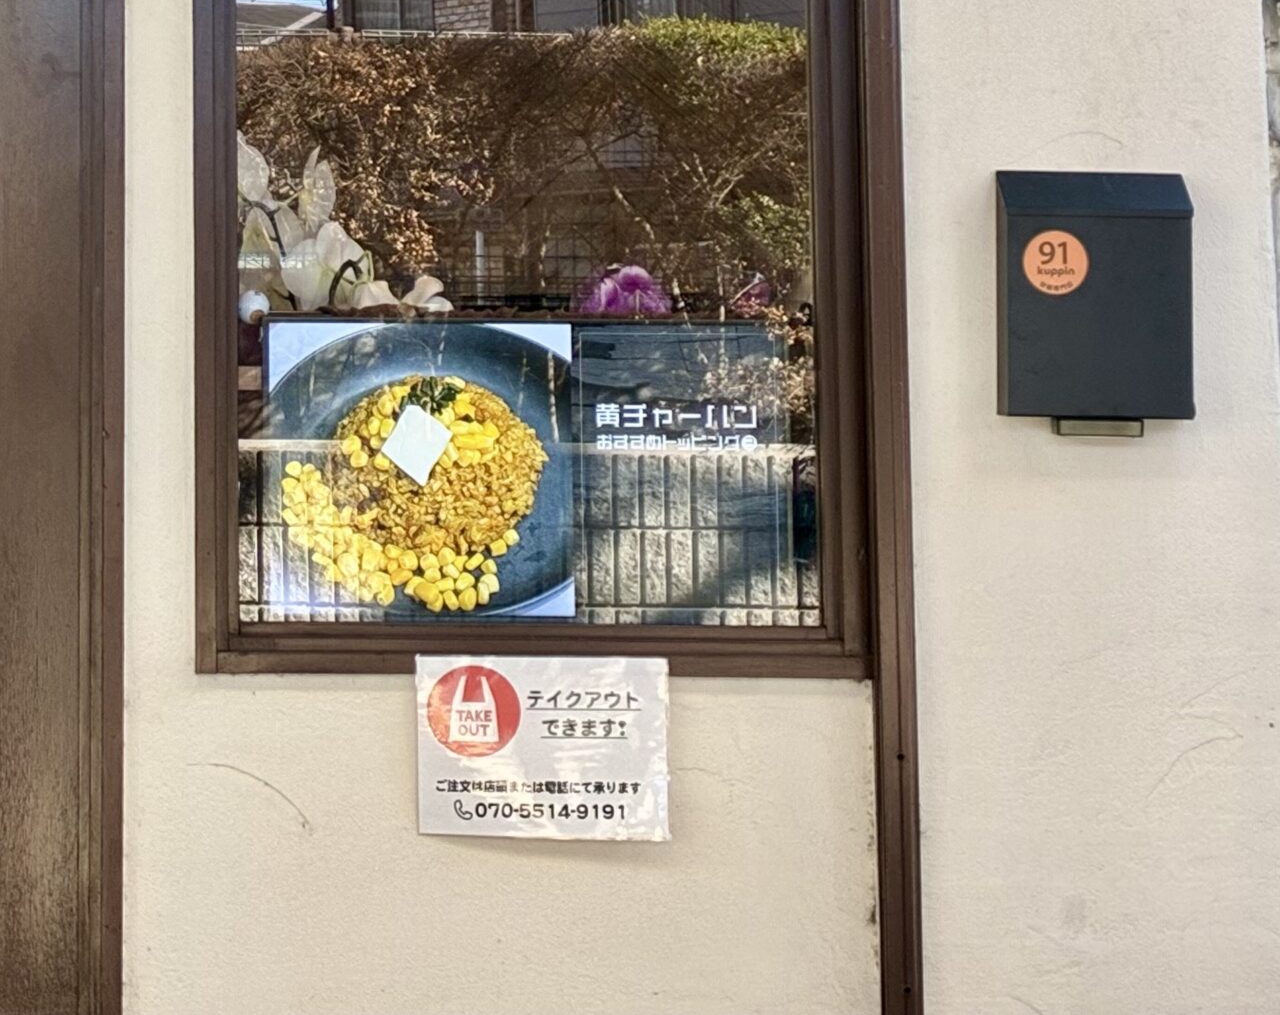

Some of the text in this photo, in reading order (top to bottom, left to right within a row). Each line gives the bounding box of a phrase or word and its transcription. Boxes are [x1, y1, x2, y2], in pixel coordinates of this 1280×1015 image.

[1038, 240, 1068, 265] 91
[526, 689, 639, 710] テイクアウト
[455, 709, 493, 723] TAKE
[458, 724, 491, 737] OUT
[475, 802, 626, 820] 070-5514-9191
